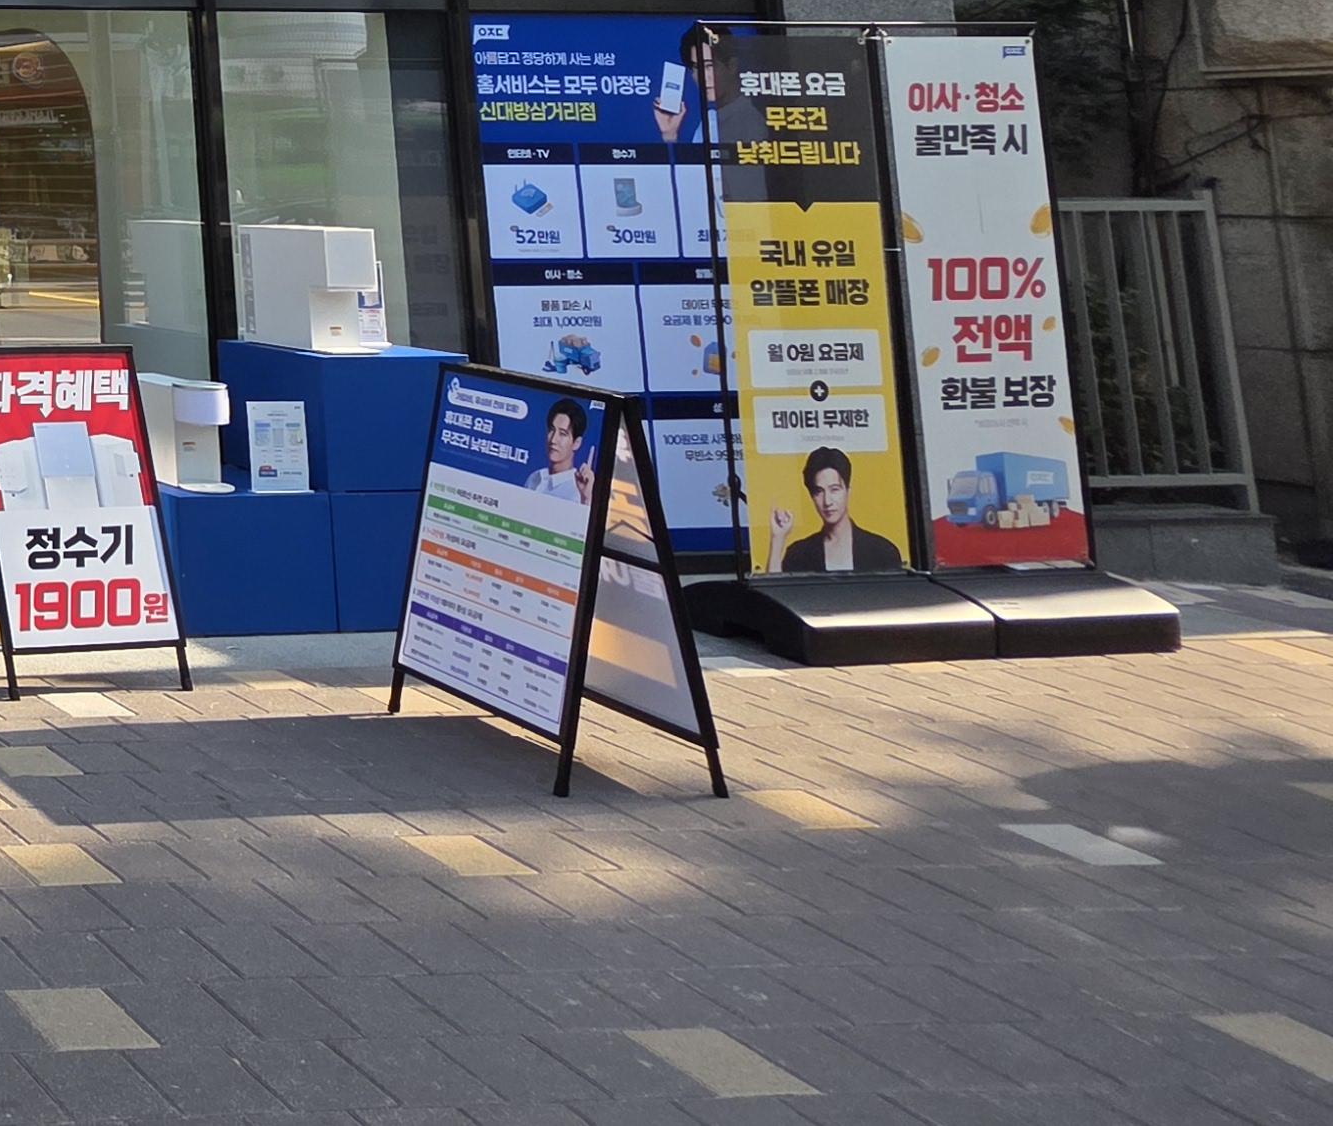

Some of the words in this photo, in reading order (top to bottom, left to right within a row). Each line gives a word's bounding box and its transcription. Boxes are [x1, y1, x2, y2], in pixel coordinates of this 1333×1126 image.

[474, 51, 520, 66] 아름답고
[521, 51, 568, 66] 정당하게
[568, 52, 592, 66] 사는
[593, 52, 616, 66] 세상
[476, 73, 561, 95] 홈서비스는
[563, 75, 598, 96] 모두
[600, 75, 651, 96] 아정당
[739, 71, 802, 97] 휴대폰
[805, 72, 846, 97] 요금
[907, 81, 1026, 113] 이사·청소
[479, 101, 597, 122] 신대방삼거리점
[765, 106, 829, 131] 무조건
[914, 123, 997, 157] 불만족
[1002, 123, 1029, 156] 시
[736, 140, 861, 166] 낮춰드립니다
[515, 229, 561, 245] 52만원
[611, 229, 657, 245] 30만원
[759, 240, 806, 267] 국내
[811, 239, 856, 267] 유일
[927, 256, 1047, 302] 100%
[681, 299, 710, 311] 데이터
[750, 279, 821, 307] 알뜰폰
[825, 279, 870, 307] 매장
[561, 300, 581, 312] 파손
[582, 300, 593, 312] 시
[532, 316, 553, 328] 최대
[555, 315, 603, 329] 1,000만원
[662, 315, 692, 326] 요금제
[951, 313, 1033, 364] 전액
[767, 343, 784, 363] 월
[786, 343, 815, 362] 0원
[818, 342, 865, 362] 요금제
[940, 375, 997, 411] 환불
[1002, 374, 1057, 409] 보장
[443, 410, 474, 430] 휴대폰
[473, 417, 494, 435] 요금
[772, 409, 820, 429] 데이터
[823, 408, 870, 428] 무제한
[440, 429, 471, 448] 무조건
[470, 436, 530, 465] 낮춰드립니다
[662, 434, 710, 445] 100원으로
[684, 450, 714, 462] 무빈소
[25, 523, 134, 570] 정수기
[14, 577, 169, 633] 1900원
